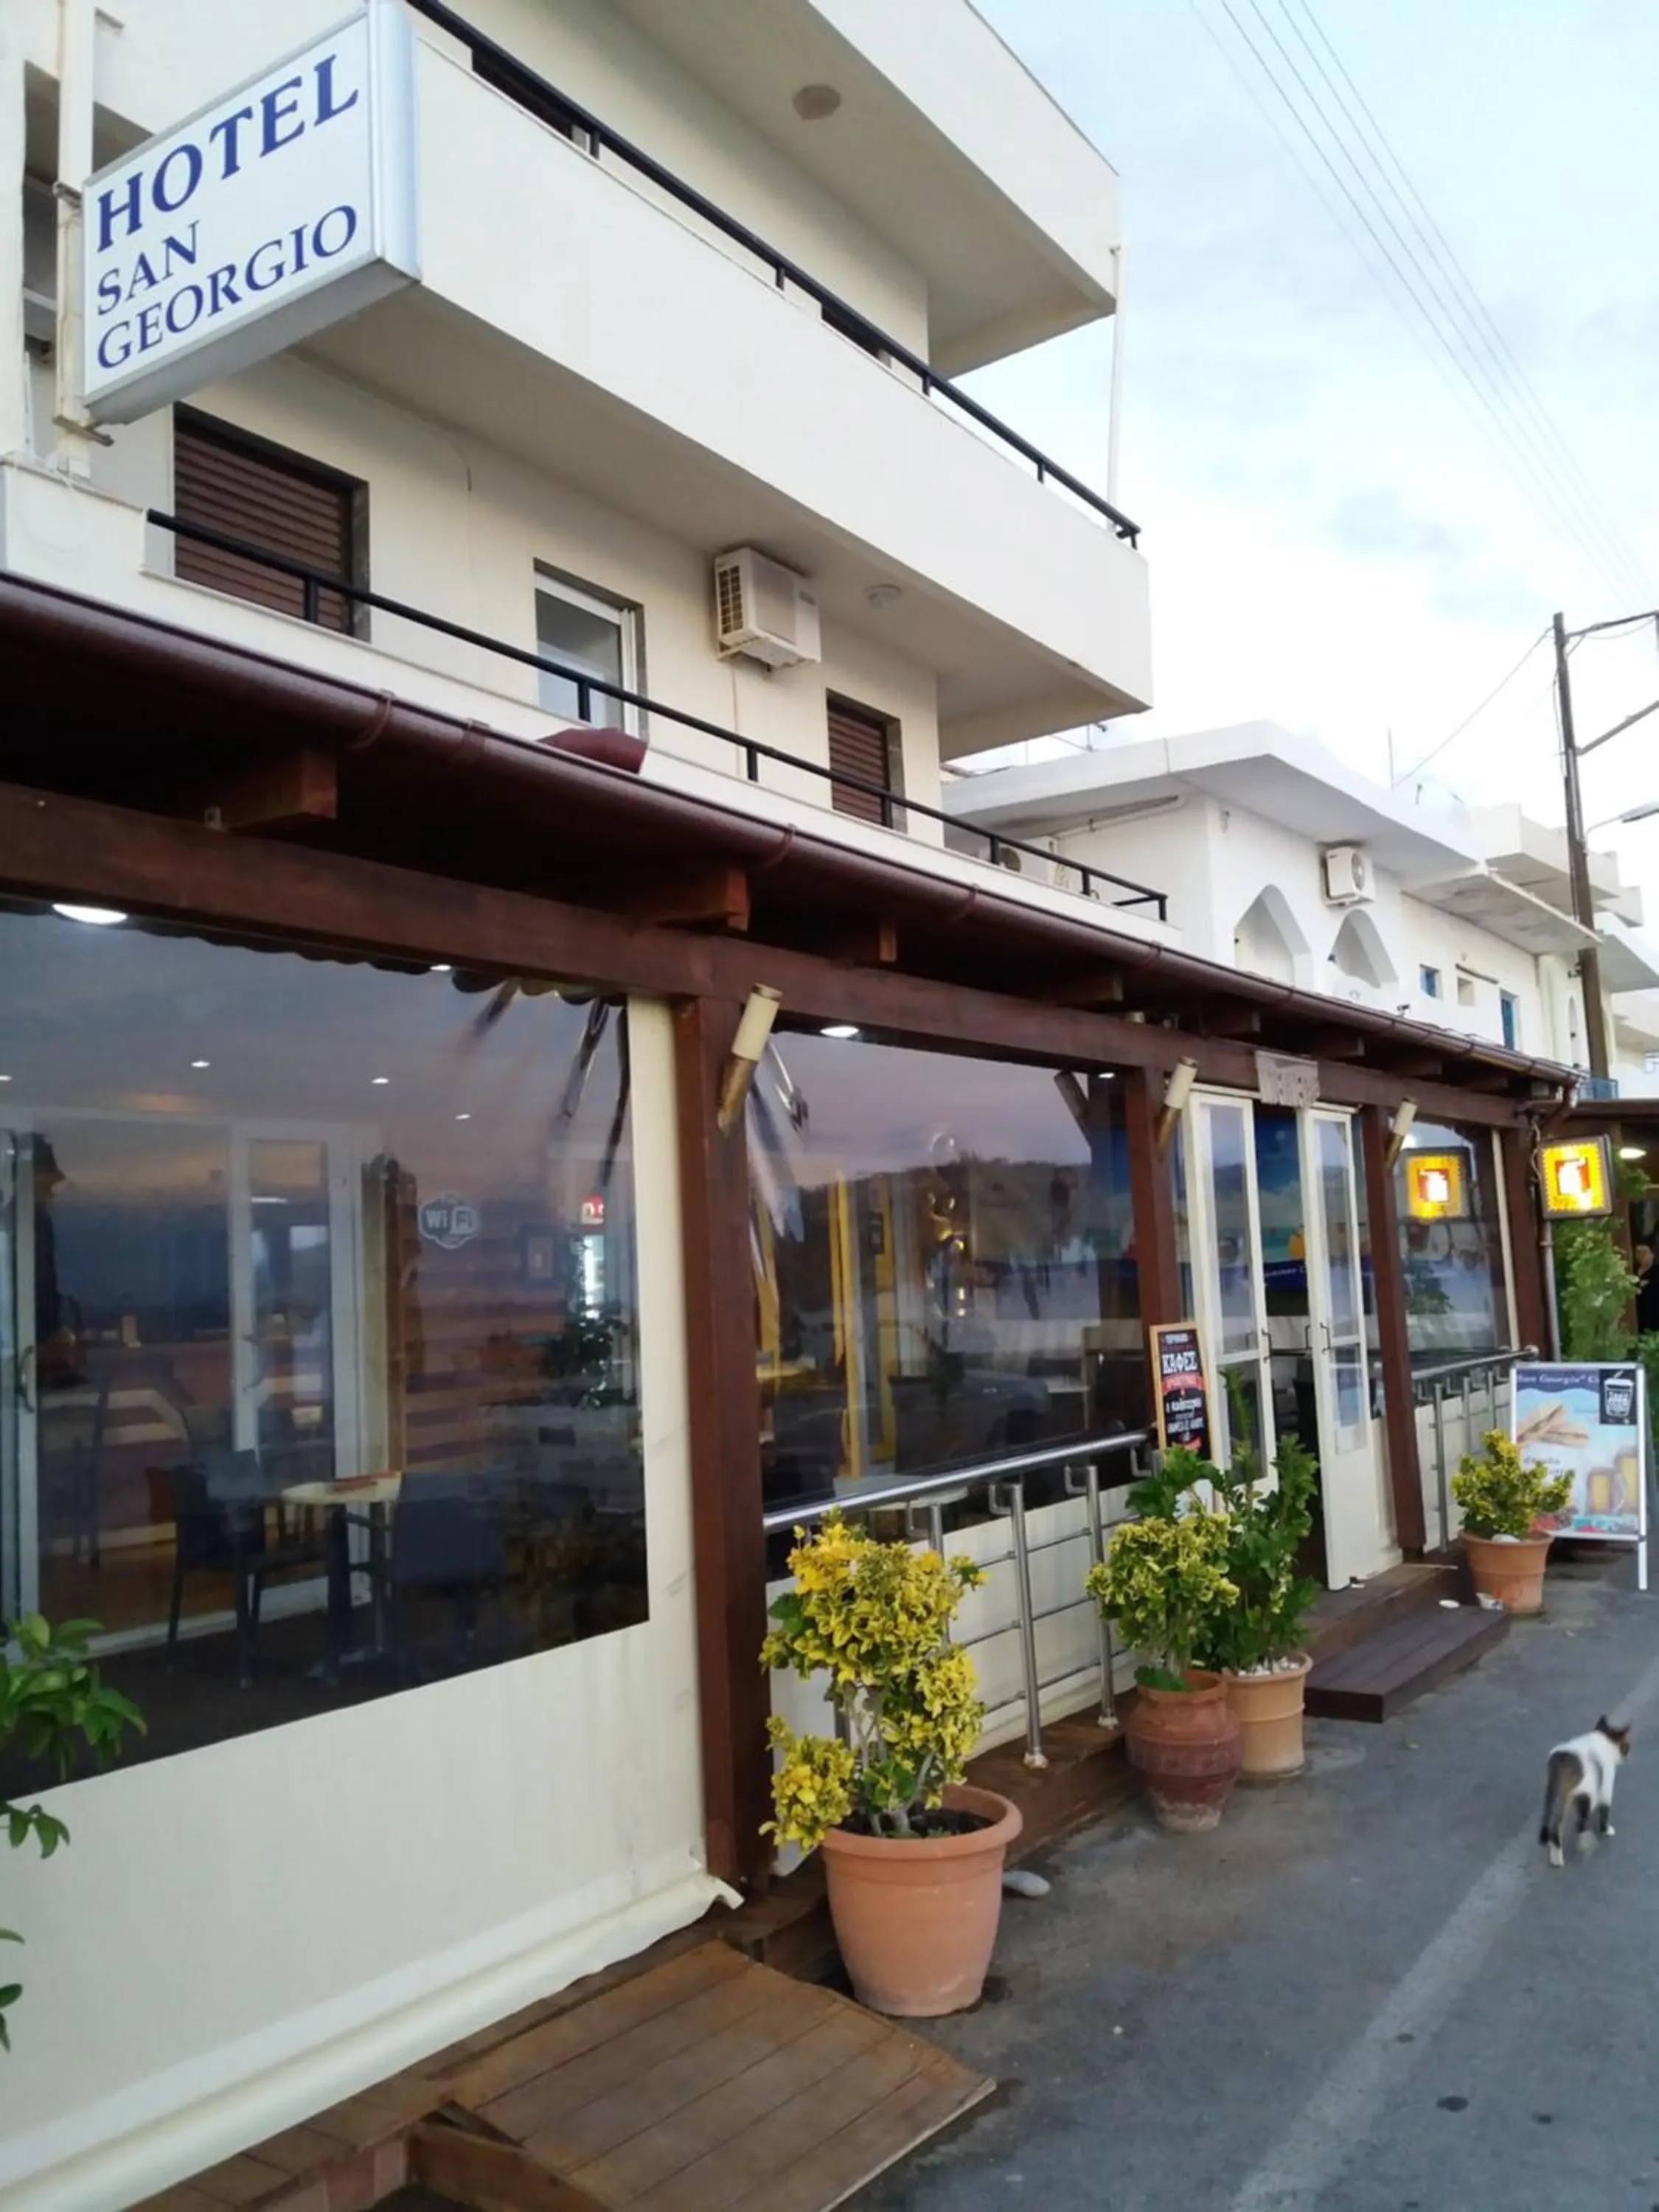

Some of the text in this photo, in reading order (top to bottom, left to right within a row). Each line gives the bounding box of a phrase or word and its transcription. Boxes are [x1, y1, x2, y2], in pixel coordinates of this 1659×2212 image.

[97, 54, 358, 253] HOTEL
[97, 220, 201, 316] SAN
[97, 204, 357, 369] GEORGIO
